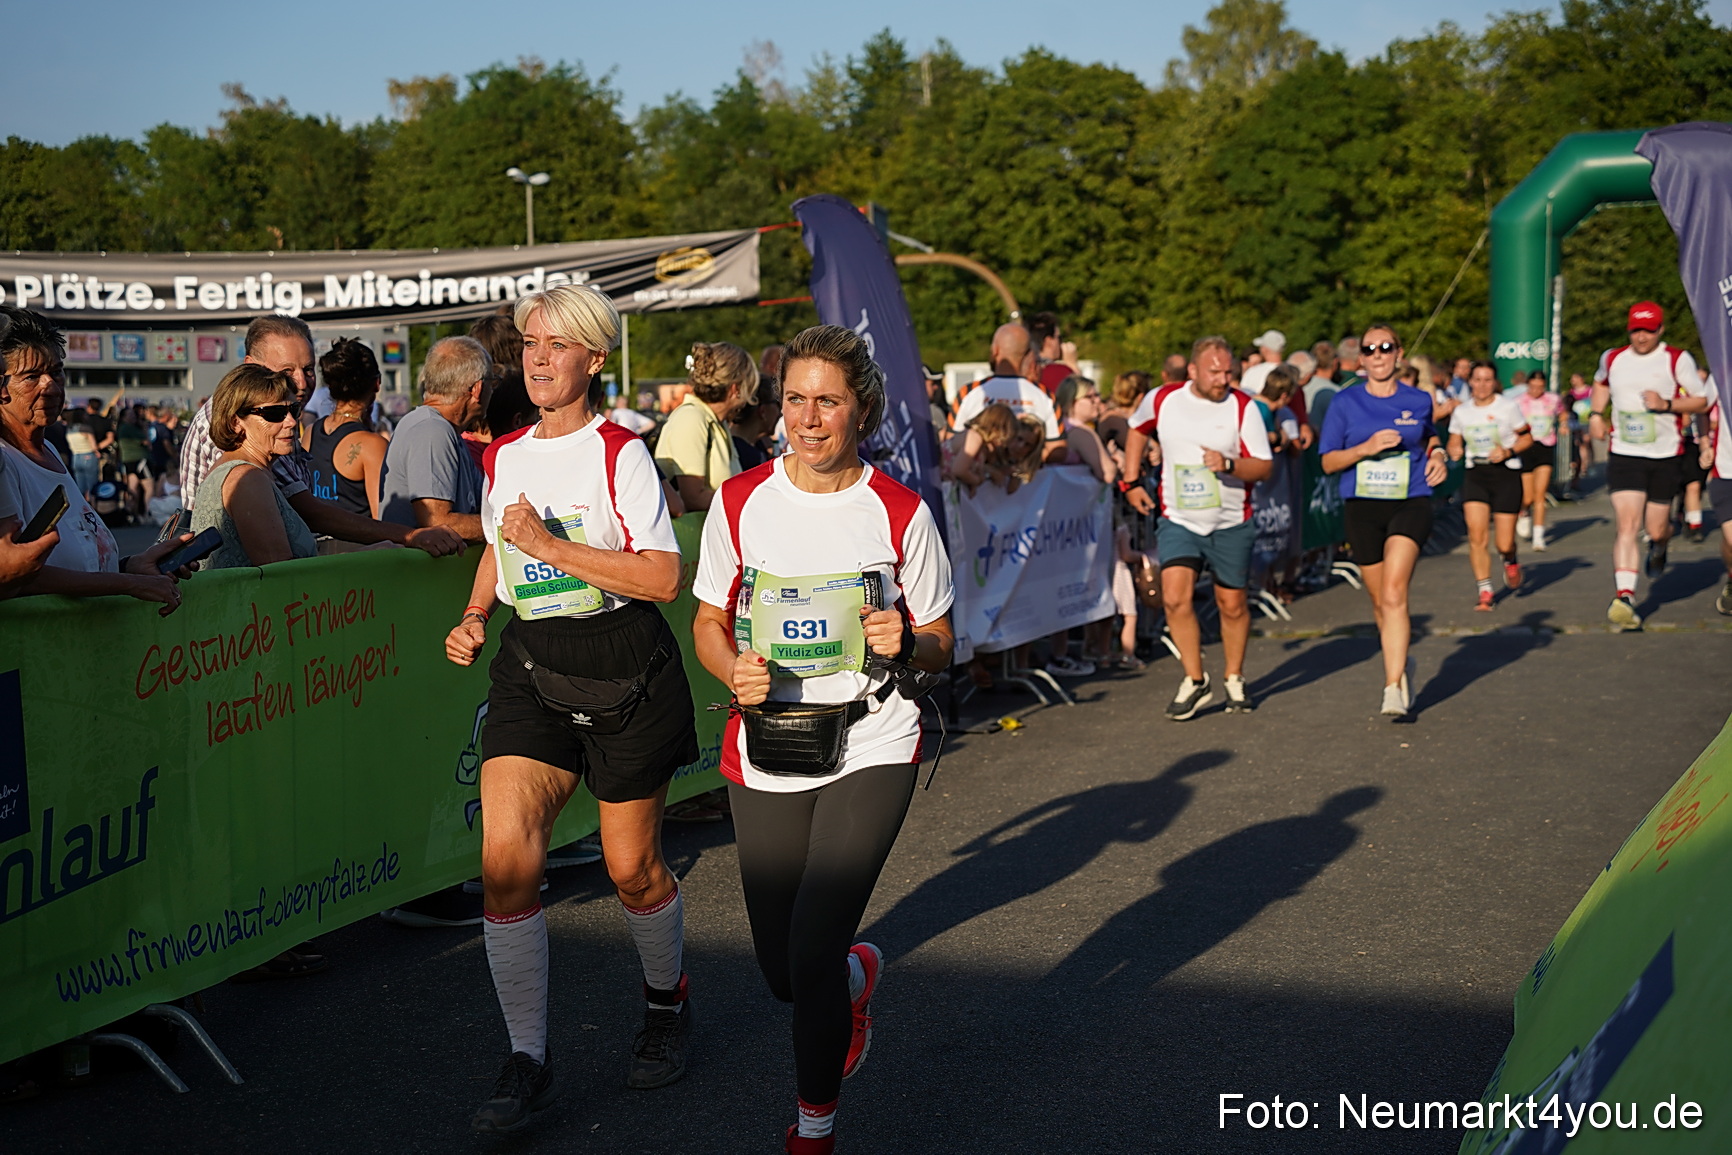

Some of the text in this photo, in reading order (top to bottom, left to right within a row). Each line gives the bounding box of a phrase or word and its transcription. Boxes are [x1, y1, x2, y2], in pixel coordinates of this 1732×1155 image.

[15, 274, 166, 310] Plätze.
[174, 272, 316, 317] Fertig.
[1495, 341, 1531, 360] AOK
[999, 515, 1097, 568] FRISCHMANN
[515, 585, 547, 597] Gisela
[776, 596, 811, 604] Firmenlauf
[136, 588, 376, 700] Gesunde Firmen
[782, 619, 828, 640] 631
[776, 643, 837, 657] Yildiz Gül
[206, 623, 400, 747] laufen länger!
[55, 842, 401, 1003] www.firmenlauf-oberpfalz.de
